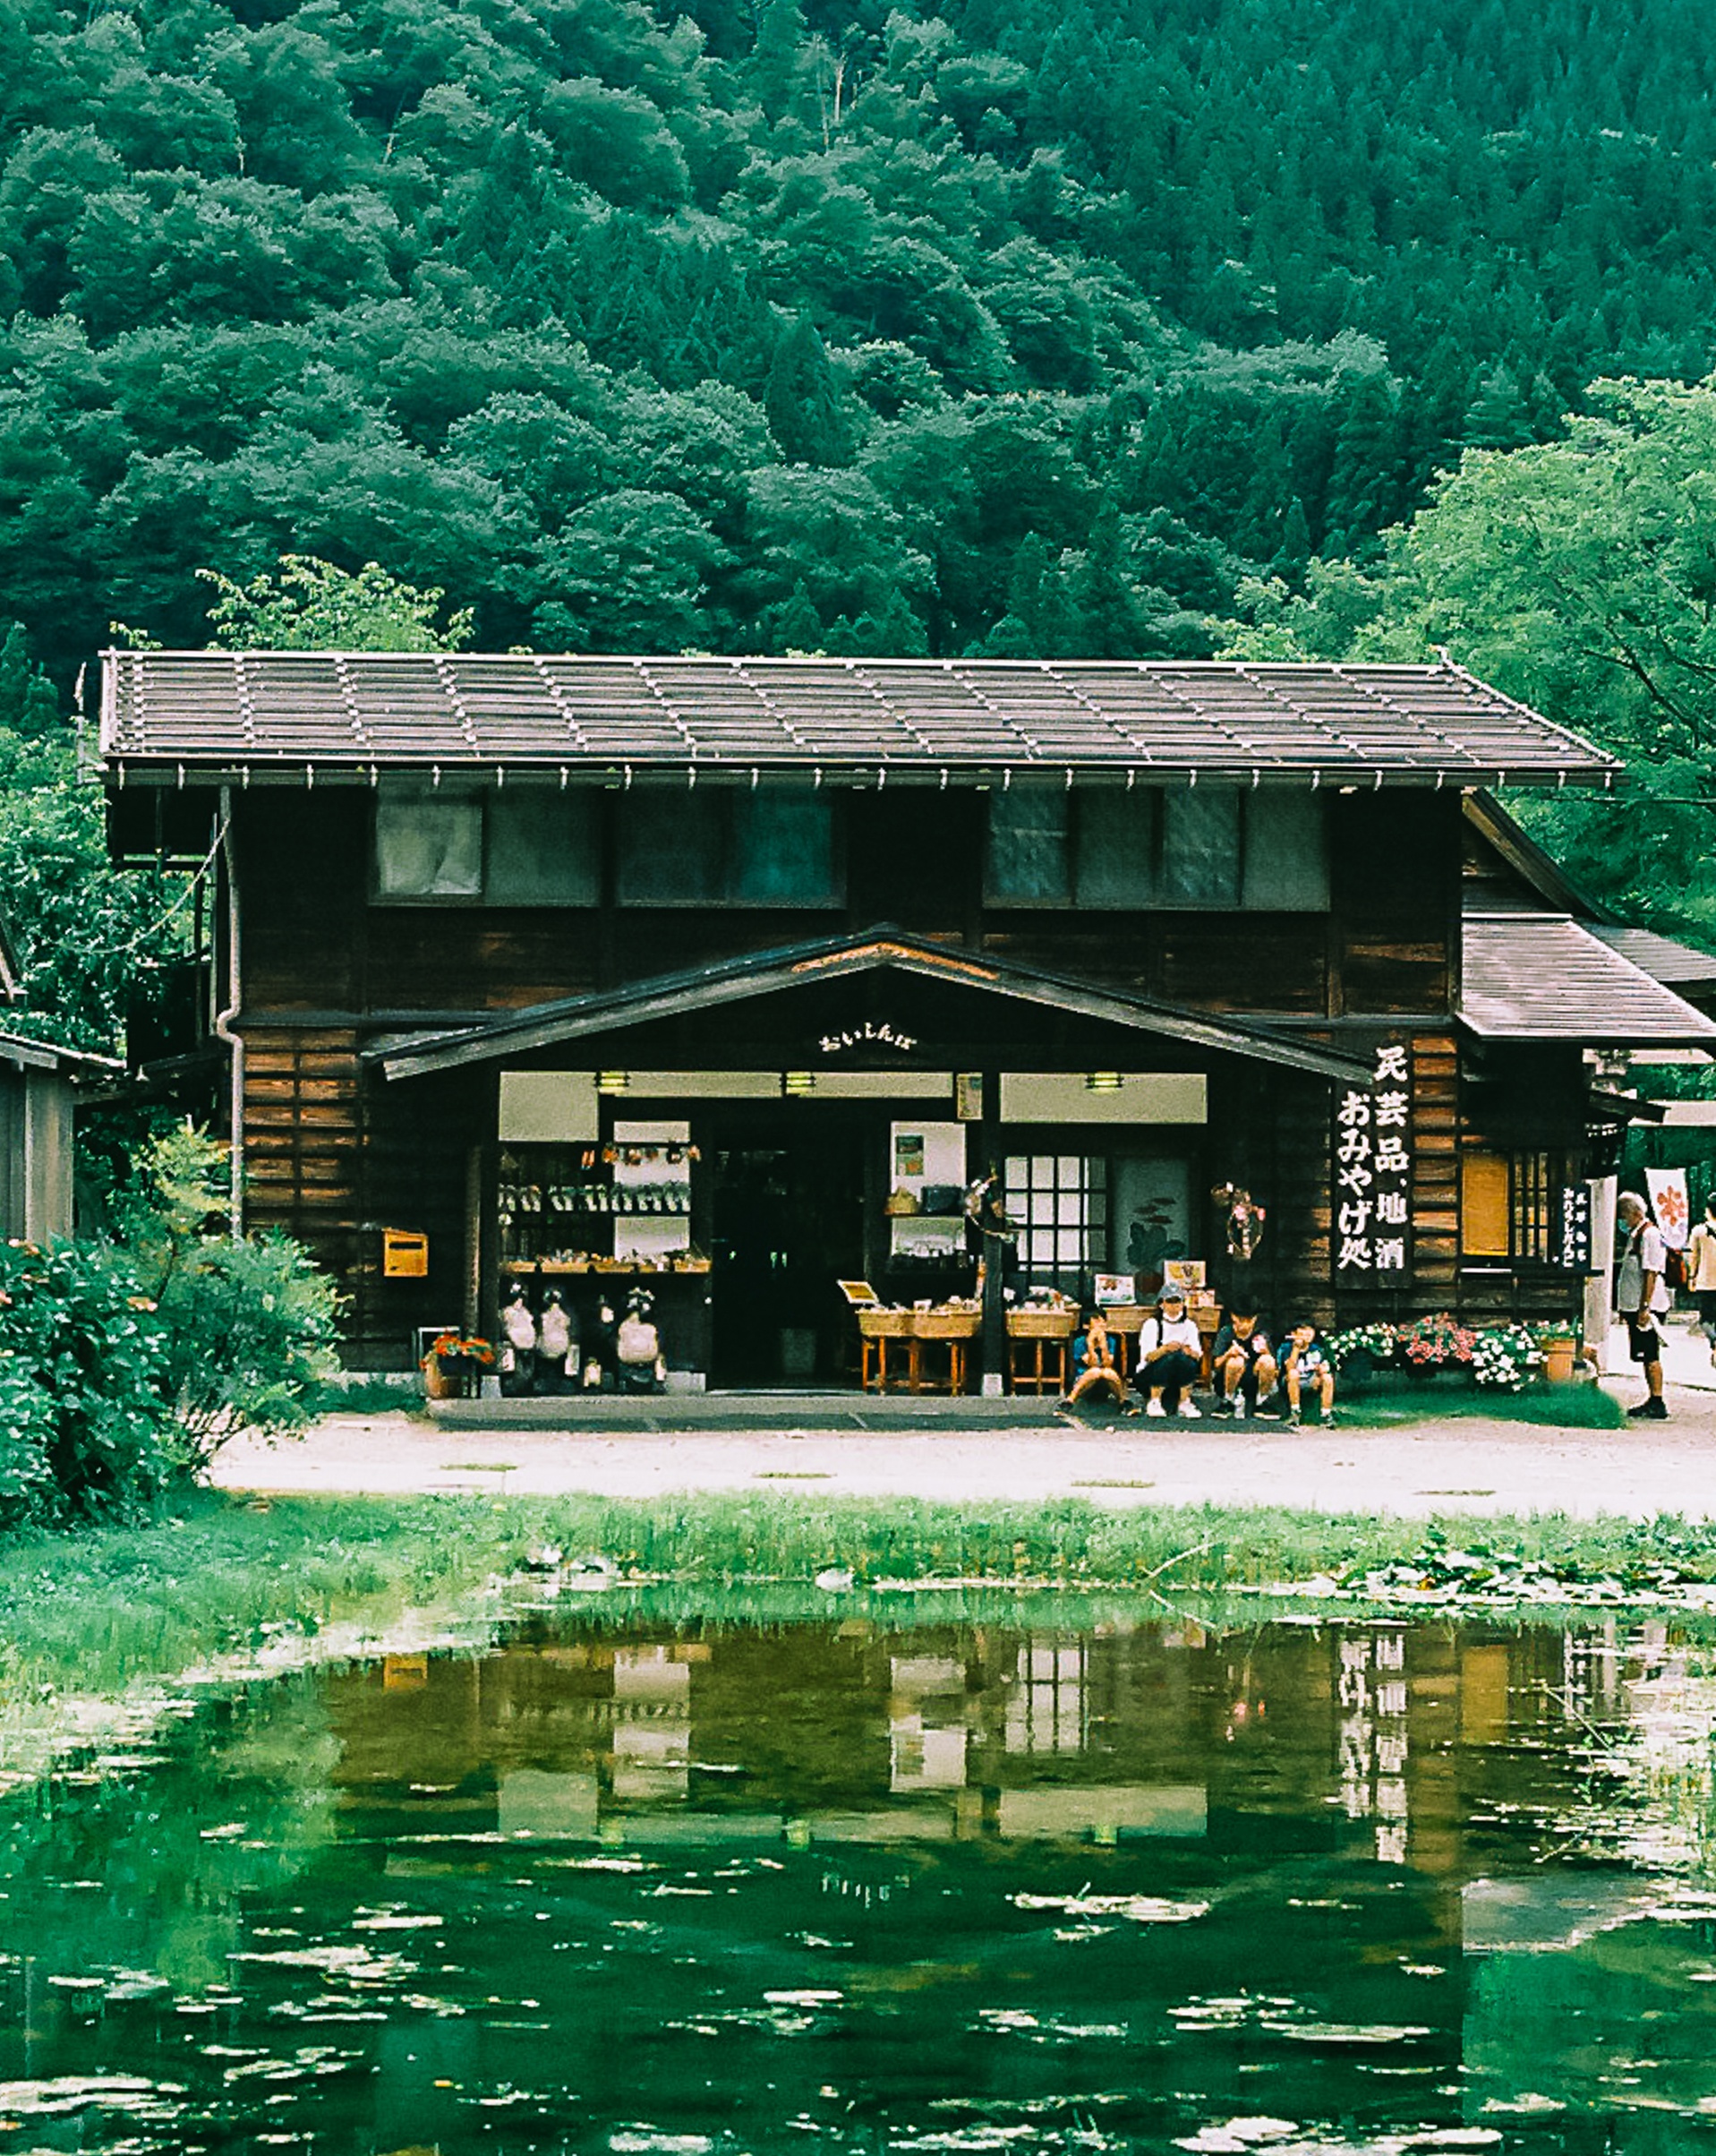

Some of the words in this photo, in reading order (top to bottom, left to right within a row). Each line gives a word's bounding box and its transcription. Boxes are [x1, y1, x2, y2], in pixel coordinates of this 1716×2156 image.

[1337, 1091, 1373, 1270] おみやげ処
